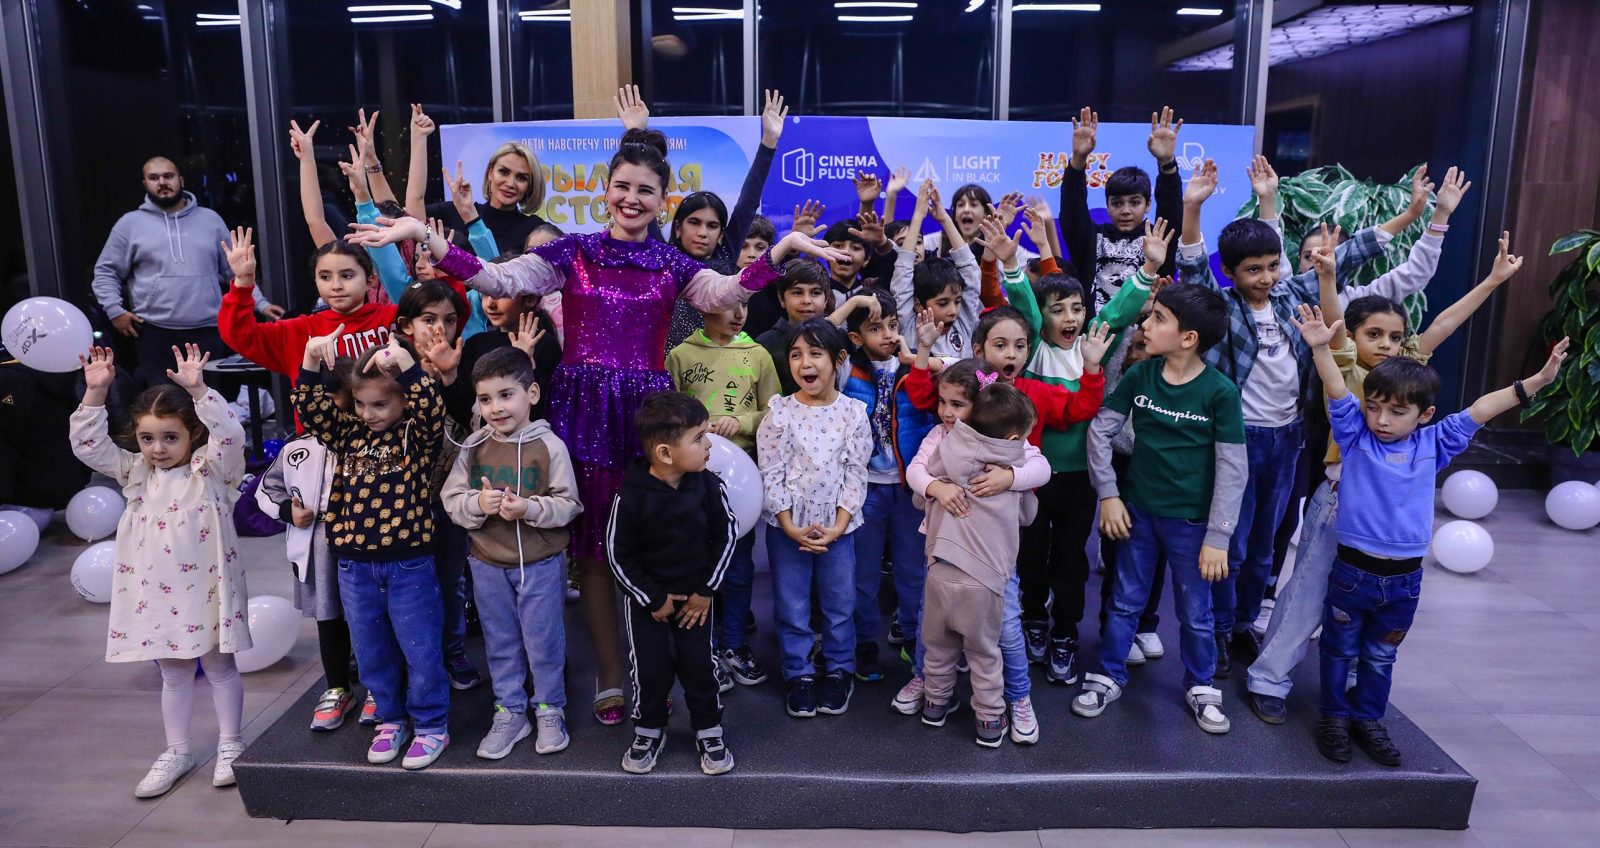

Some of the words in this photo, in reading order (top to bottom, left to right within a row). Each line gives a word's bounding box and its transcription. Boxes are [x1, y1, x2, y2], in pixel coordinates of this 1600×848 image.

[549, 137, 599, 150] НАВСТРЕЧУ
[818, 155, 878, 168] CINEMA
[952, 155, 1001, 170] LIGHT
[1039, 152, 1111, 170] HAPY
[818, 168, 856, 180] PLUS
[952, 172, 964, 183] IN
[966, 172, 1001, 183] BLACK
[21, 327, 49, 355] 4DX
[342, 323, 397, 361] DIEG
[1134, 394, 1209, 423] Champion
[291, 450, 304, 462] 97
